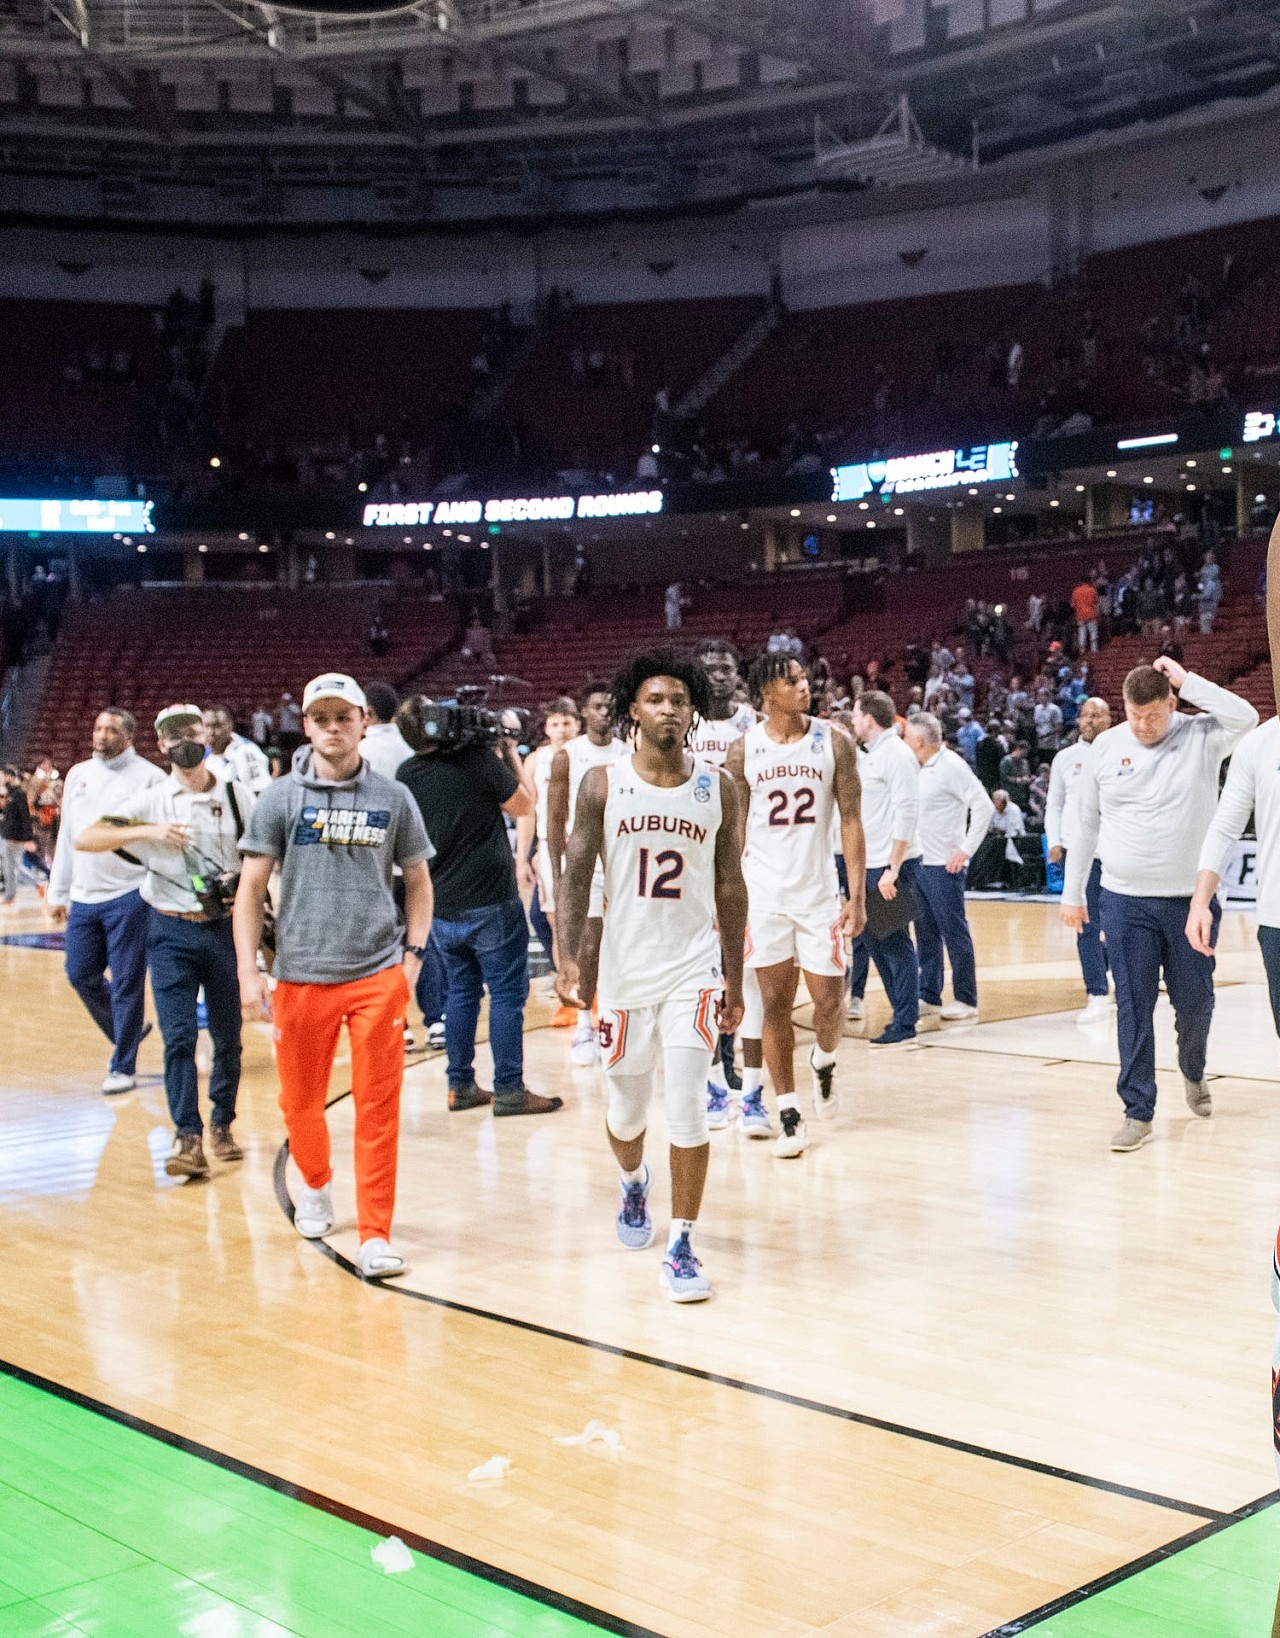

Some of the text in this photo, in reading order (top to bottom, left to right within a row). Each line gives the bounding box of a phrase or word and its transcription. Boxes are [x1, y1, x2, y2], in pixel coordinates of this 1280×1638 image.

[363, 502, 434, 526] FIRST
[433, 500, 482, 524] AND
[756, 765, 823, 786] AUBURN
[768, 787, 816, 827] 22
[616, 815, 707, 844] AUBURN
[638, 847, 684, 899] 12
